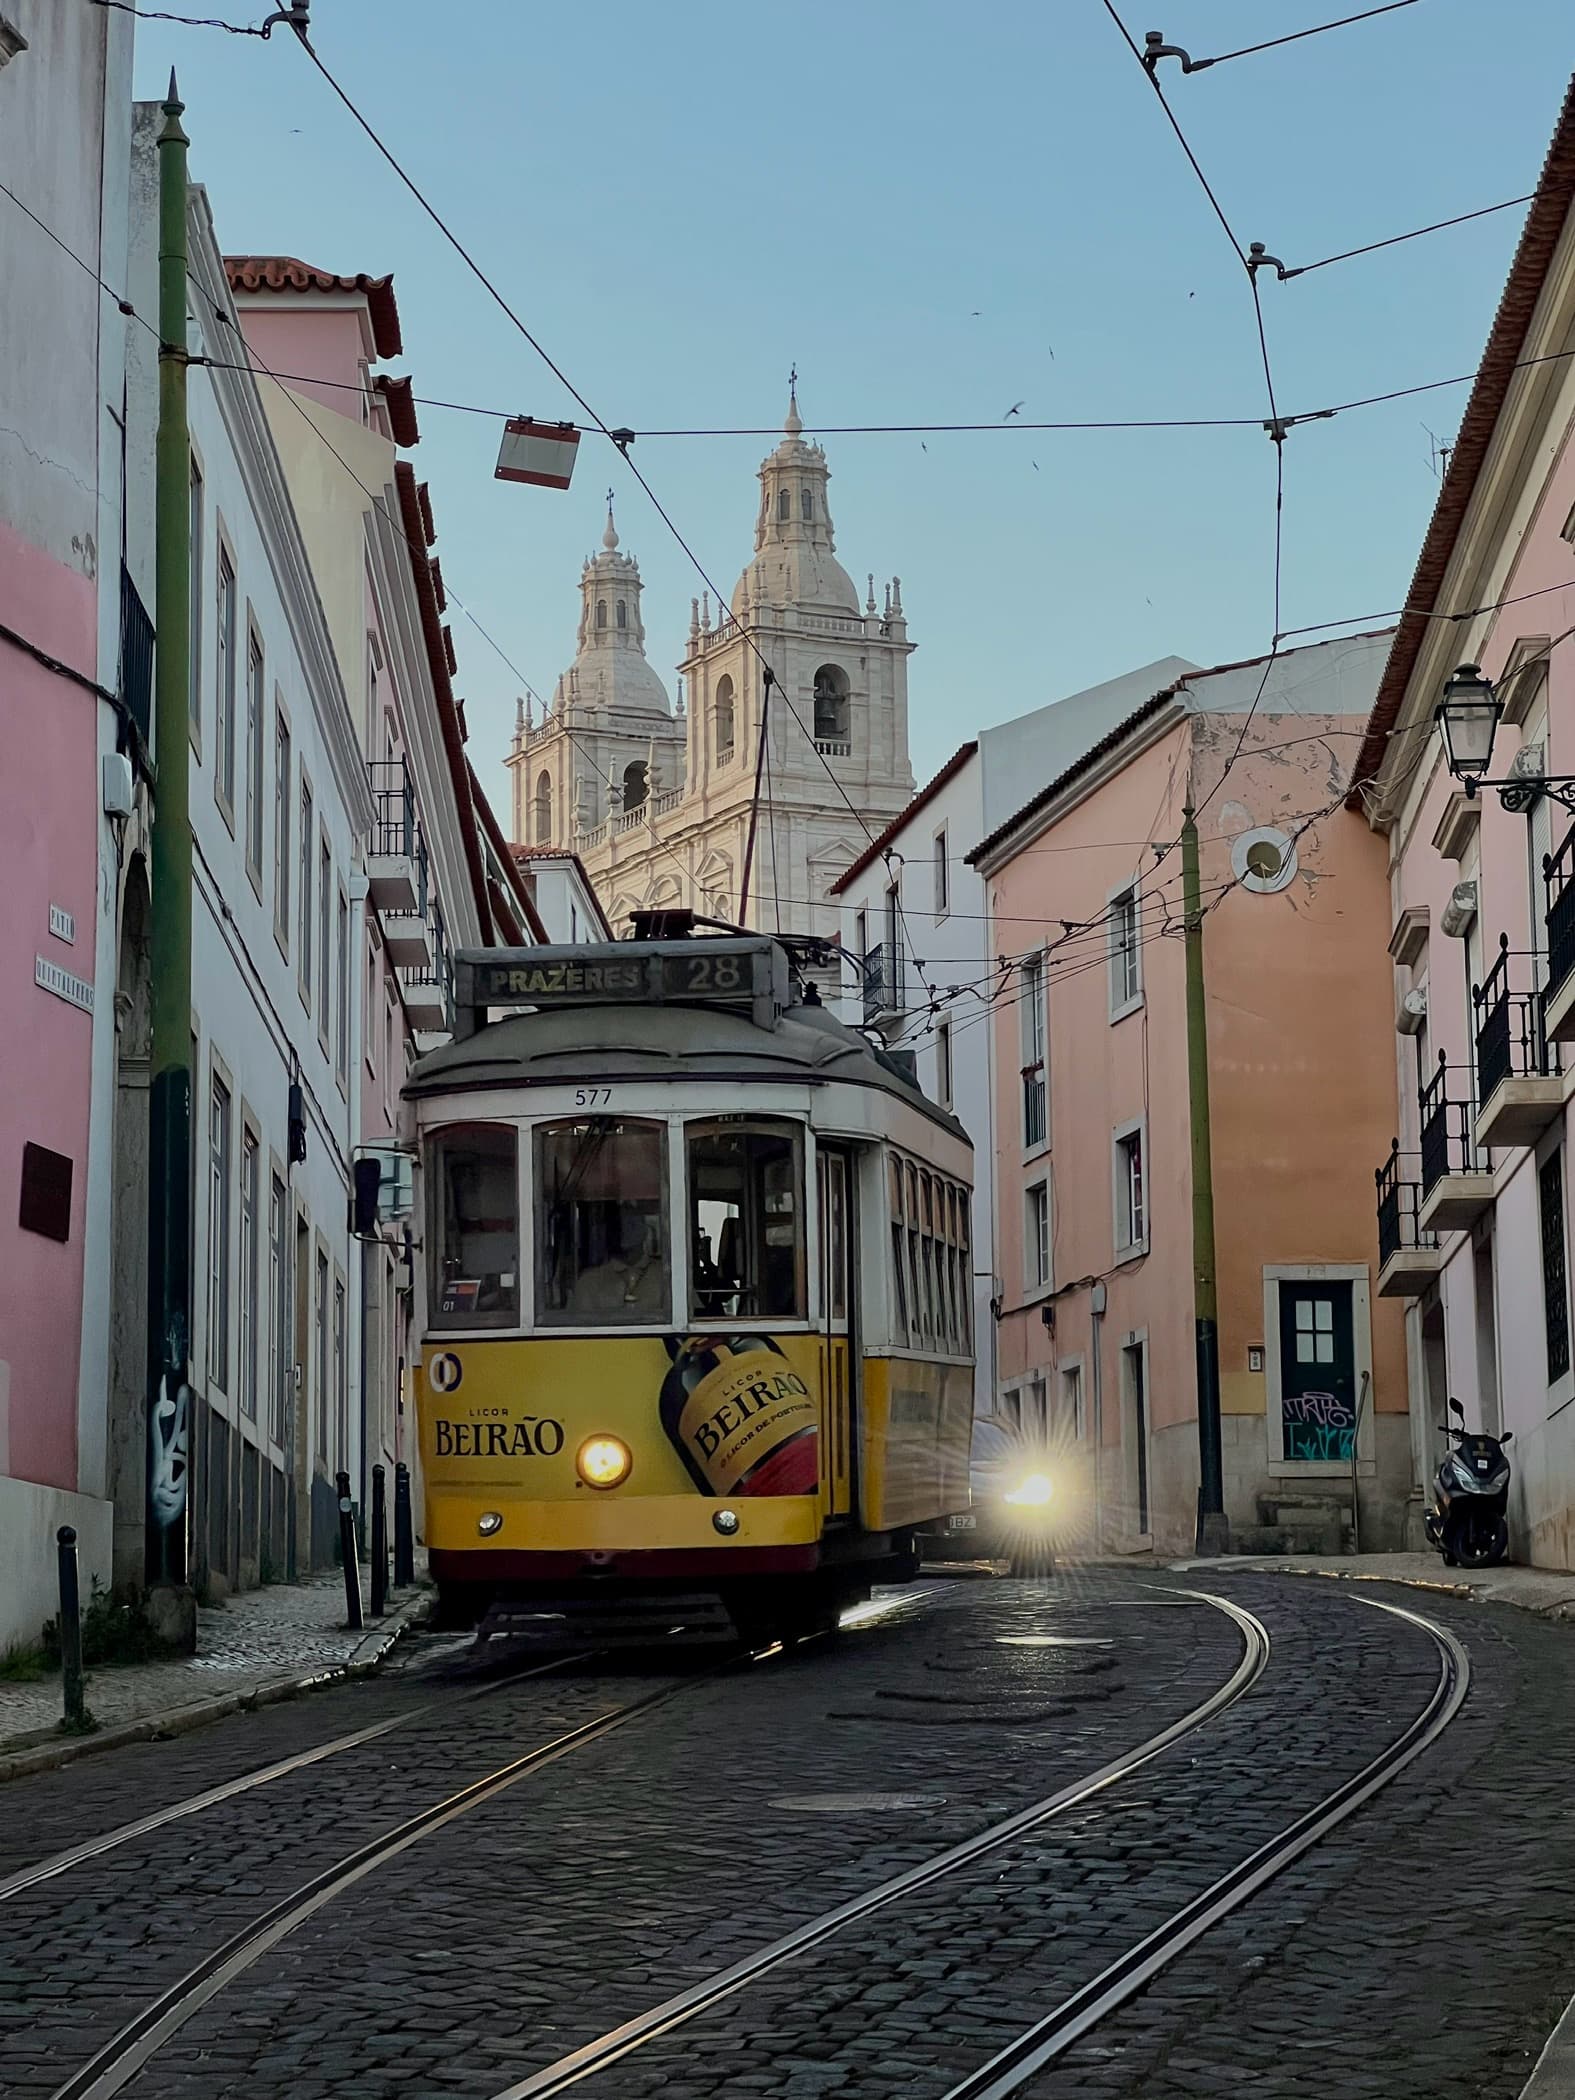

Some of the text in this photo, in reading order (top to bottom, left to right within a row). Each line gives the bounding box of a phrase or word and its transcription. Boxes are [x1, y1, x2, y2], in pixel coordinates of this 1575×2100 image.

[491, 955, 741, 993] PRAZERES 28
[575, 1089, 612, 1106] 577
[722, 1370, 763, 1397] LICOR
[469, 1408, 509, 1417] LICOR
[694, 1371, 808, 1463] BEIRÃO
[435, 1416, 565, 1456] BEIRÃO
[726, 1431, 755, 1462] LICOR
[755, 1419, 771, 1433] DE
